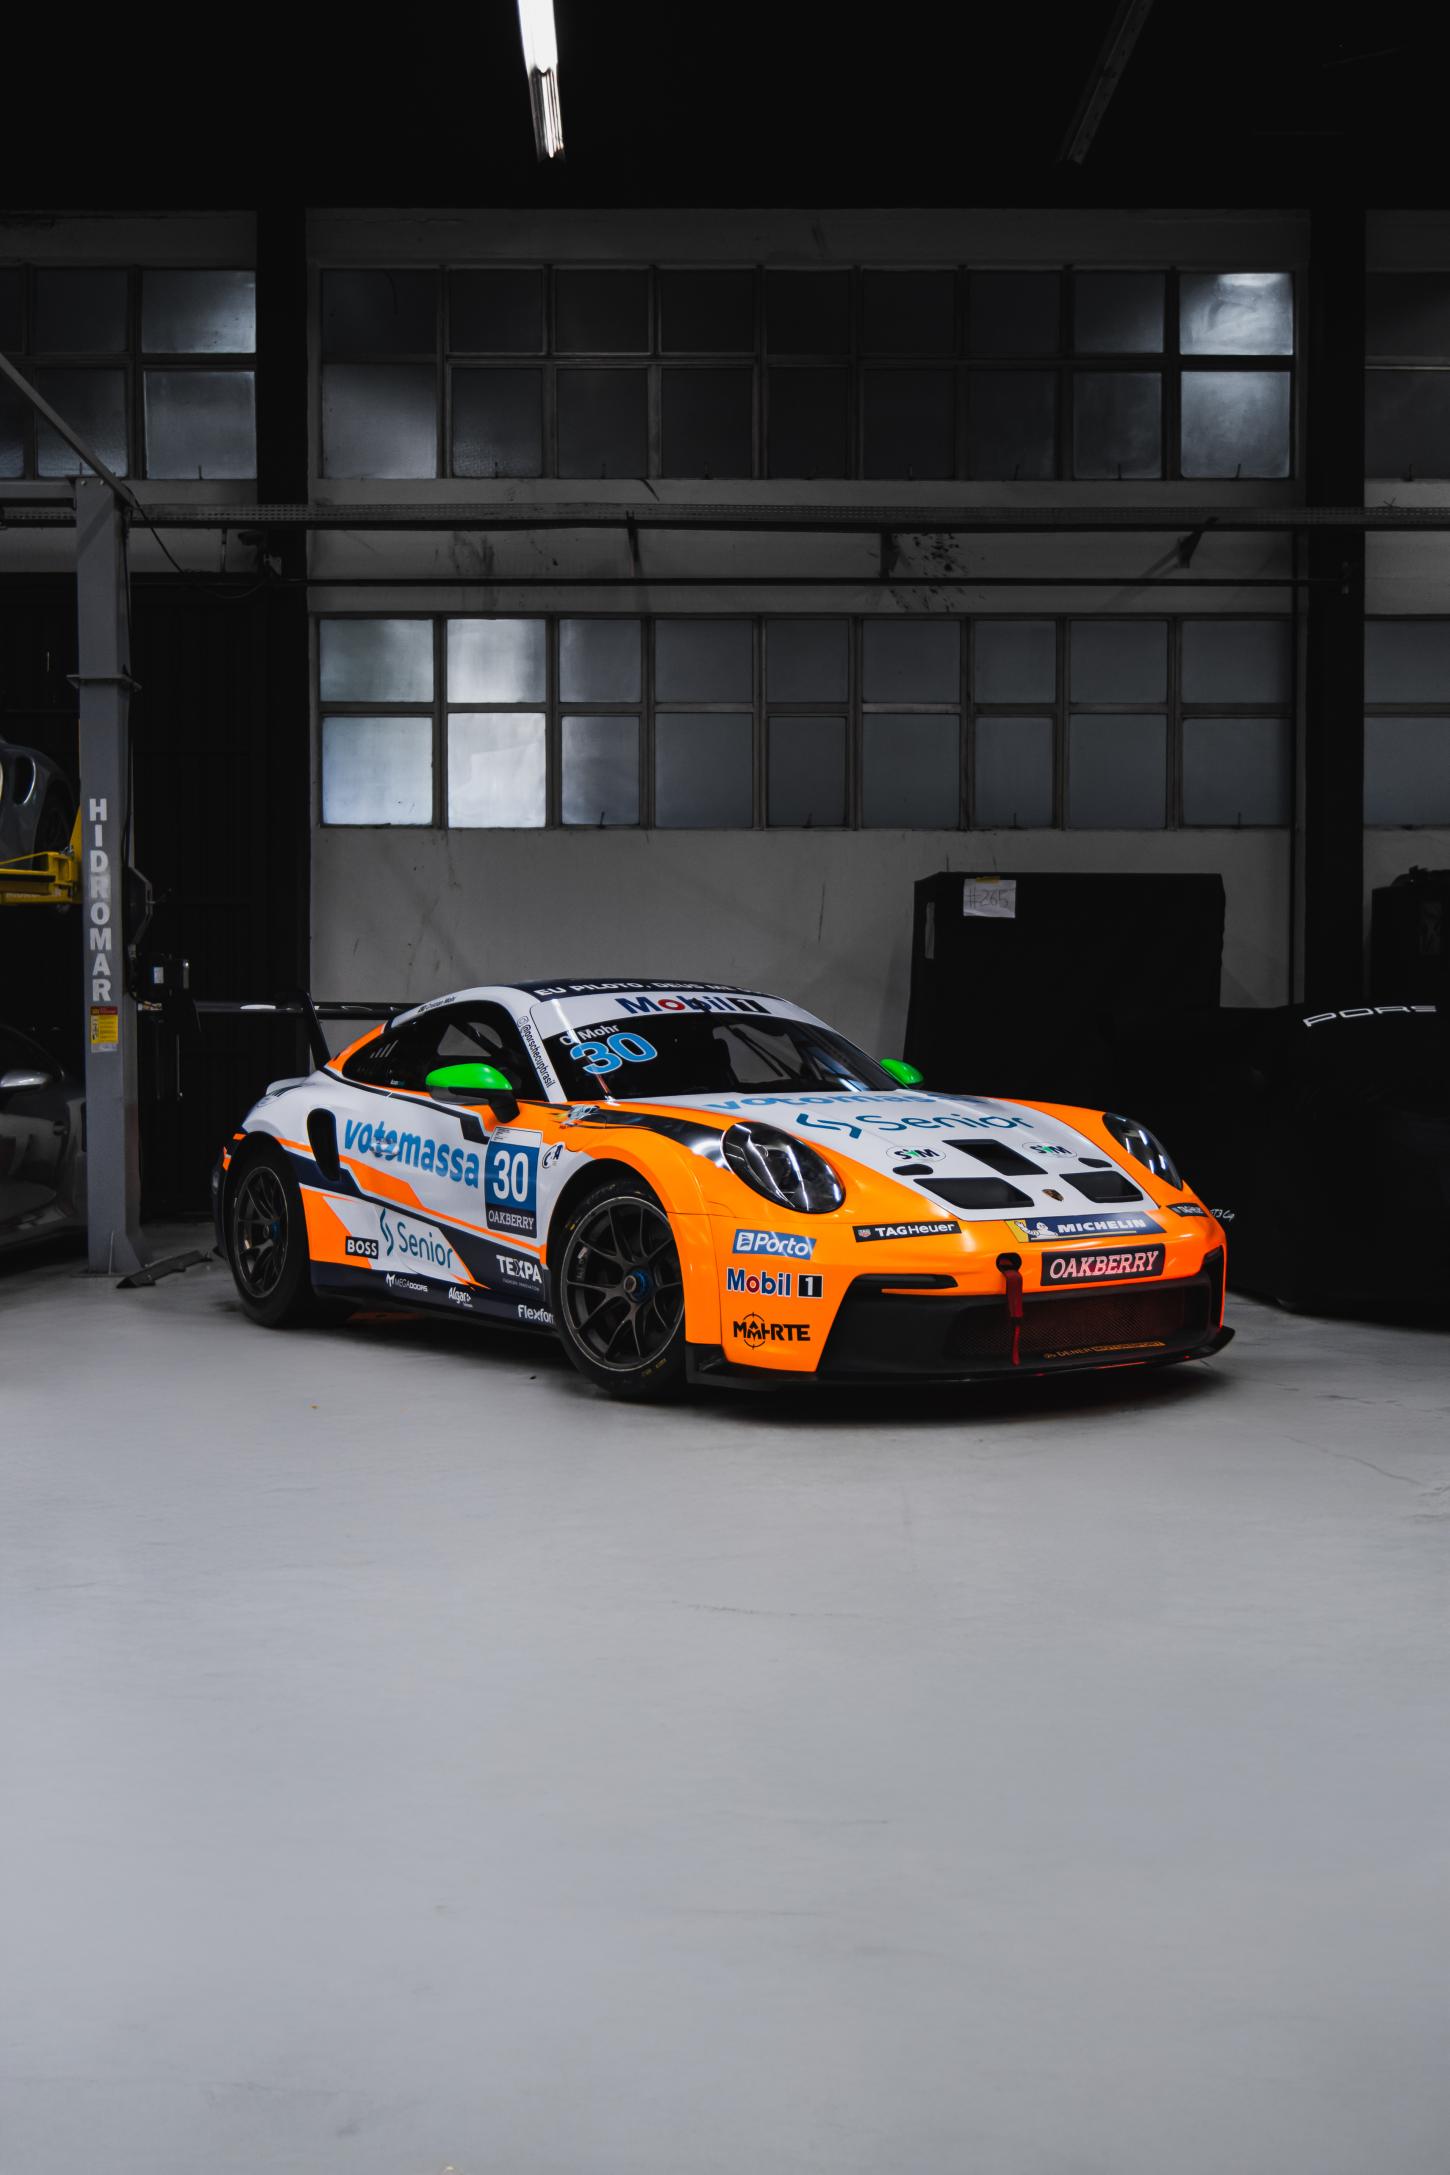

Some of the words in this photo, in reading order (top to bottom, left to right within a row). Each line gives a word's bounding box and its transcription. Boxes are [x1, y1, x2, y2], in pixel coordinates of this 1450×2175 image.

[89, 798, 112, 1002] HIDROMAR
[533, 987, 564, 997] EU
[614, 995, 737, 1014] Mobil
[577, 1024, 620, 1041] Mohr
[569, 1032, 658, 1075] 30
[855, 1113, 1034, 1131] Senior
[492, 1150, 529, 1203] 30
[488, 1210, 535, 1230] OAKBERRY
[1057, 1219, 1147, 1234] MICHELIN
[347, 1239, 378, 1256] BOSS
[397, 1221, 454, 1268] Senior
[754, 1233, 809, 1256] Porto
[495, 1254, 543, 1284] TEXPA
[1050, 1251, 1159, 1279] OAKBERRY
[727, 1267, 792, 1297] Mobil
